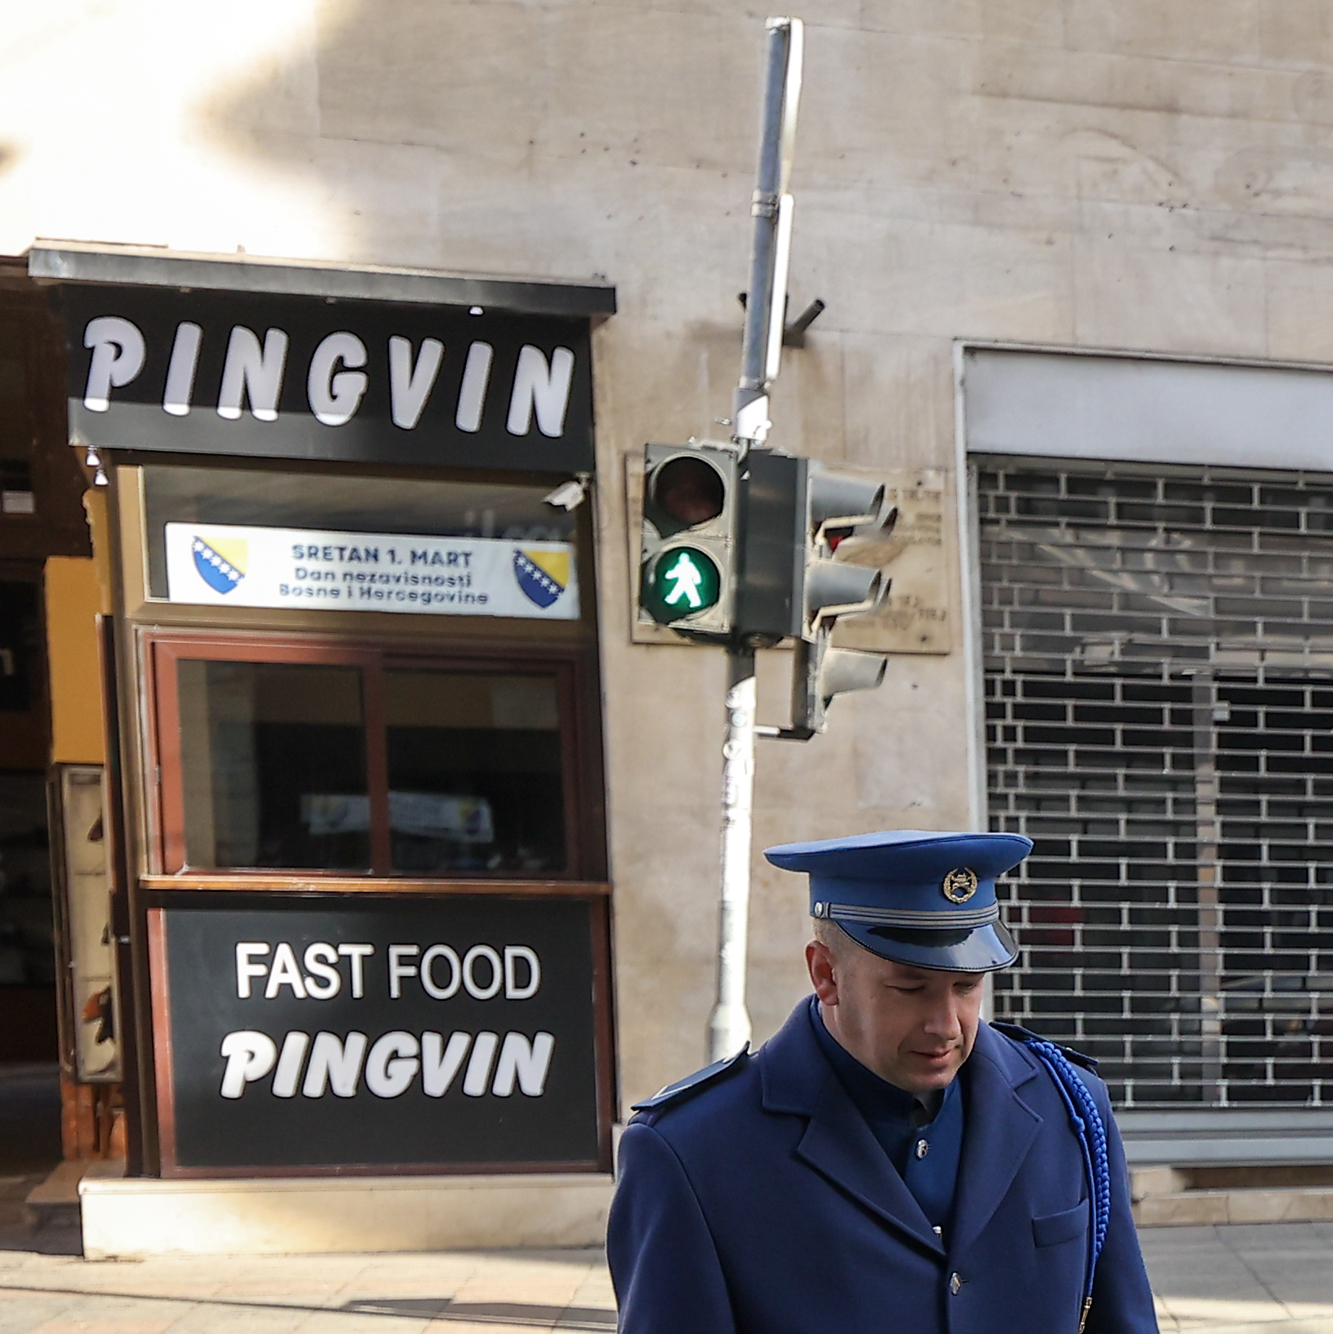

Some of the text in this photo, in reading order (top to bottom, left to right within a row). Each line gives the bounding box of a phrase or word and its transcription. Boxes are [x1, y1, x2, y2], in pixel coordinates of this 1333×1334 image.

[82, 315, 576, 438] PINGVIN
[291, 544, 473, 568] SRETAN 1. MART
[279, 583, 489, 606] Bosne i Hercegovine
[295, 567, 473, 588] Dan nezavisnosti
[235, 942, 542, 1001] FAST FOOD
[220, 1031, 556, 1099] PINGVIN
